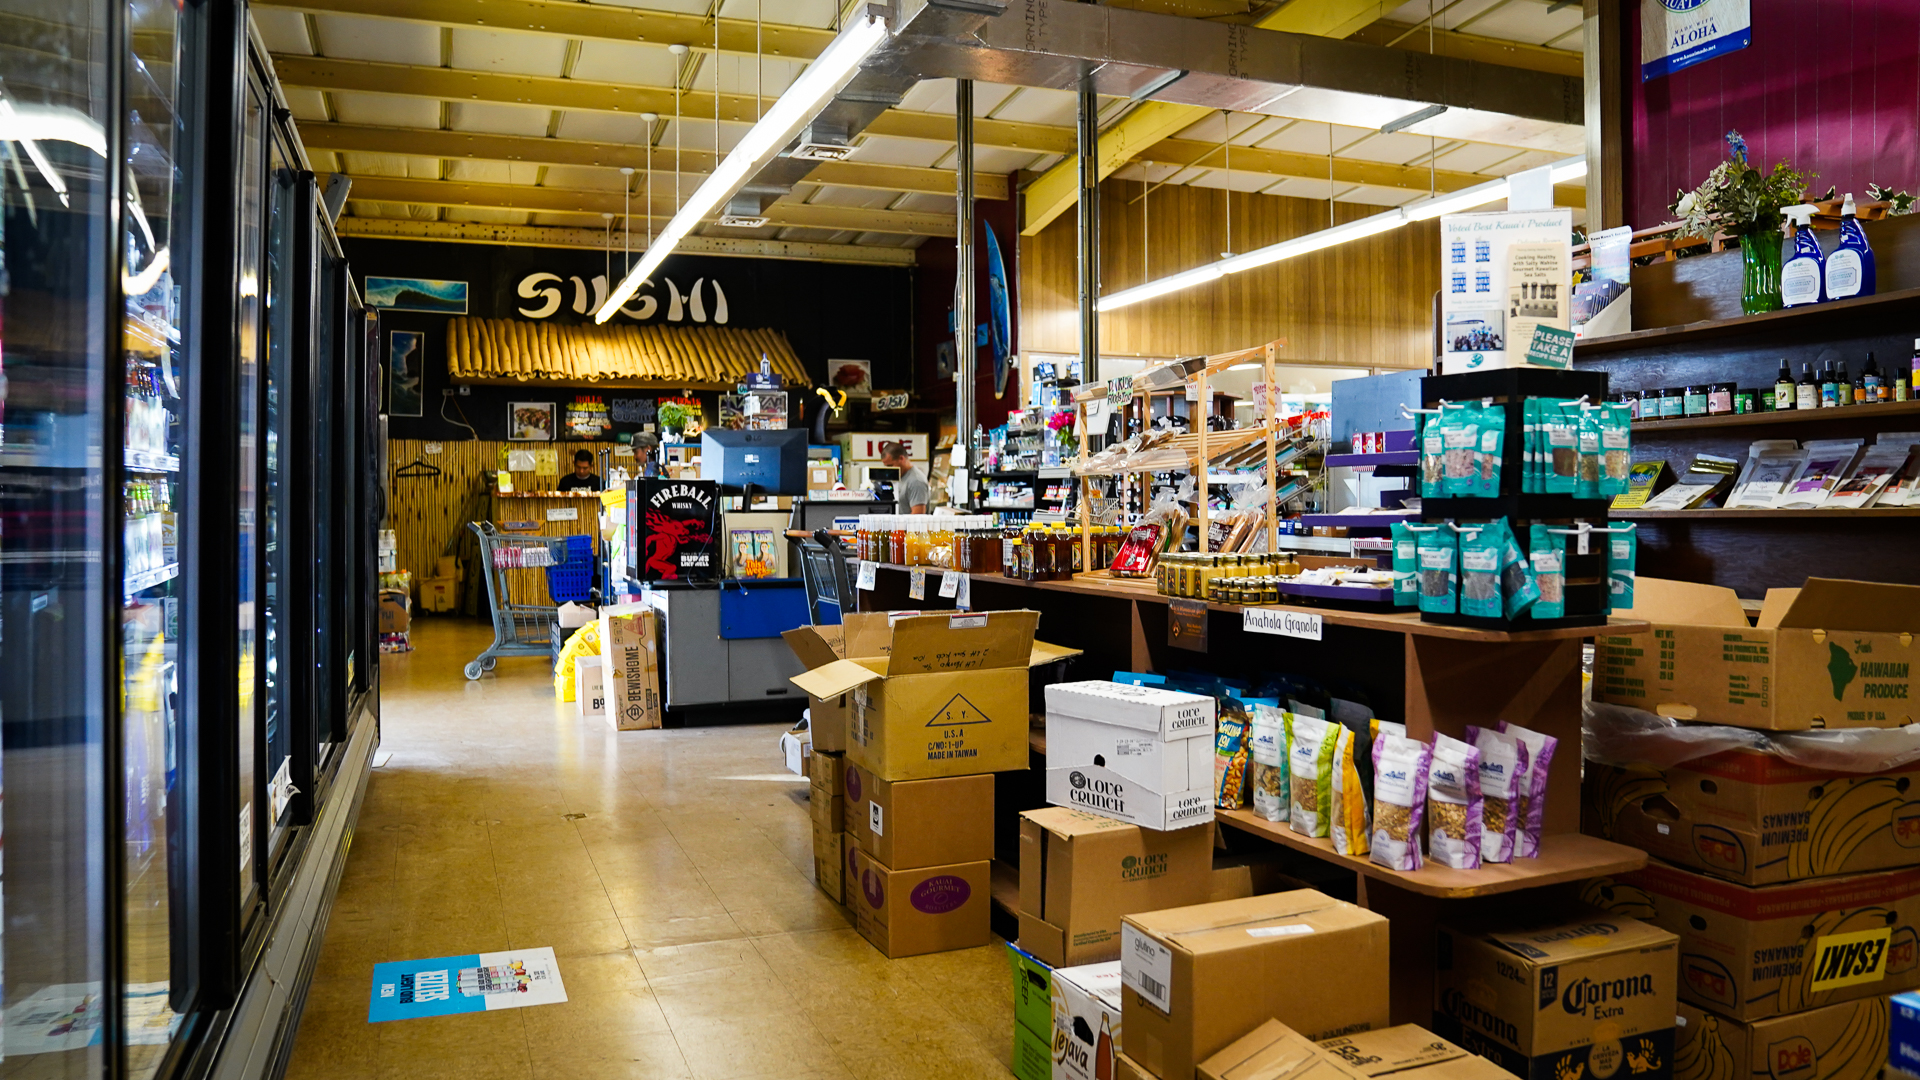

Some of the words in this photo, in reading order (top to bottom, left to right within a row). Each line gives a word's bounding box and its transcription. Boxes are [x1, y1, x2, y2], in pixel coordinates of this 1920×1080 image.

[1671, 23, 1717, 49] ALOHA
[1448, 223, 1471, 232] Voted
[1473, 222, 1493, 231] Best
[1527, 218, 1562, 228] Product
[1534, 330, 1572, 348] PLEASE
[1532, 340, 1559, 355] TAKE
[1560, 347, 1568, 357] A
[650, 484, 712, 510] FIREBALL
[1244, 610, 1282, 630] Anahola
[1284, 613, 1319, 634] Granola
[1655, 630, 1664, 638] NET
[625, 646, 641, 702] BEWISHOME
[1860, 662, 1909, 678] HAWAIIAN
[1864, 684, 1909, 699] PRODUCE
[1847, 711, 1865, 720] PRODUCE
[944, 729, 964, 738] U.S.A
[1218, 723, 1241, 737] MAUNA
[1218, 735, 1230, 748] LOA
[928, 751, 945, 760] MADE
[946, 751, 953, 759] IN
[955, 749, 978, 759] TAIWAN
[1763, 810, 1811, 829] BANANAS
[1896, 817, 1920, 839] ole
[1761, 827, 1809, 847] PREMIUM
[1700, 838, 1737, 863] Dole
[920, 885, 961, 898] GOURMET
[928, 879, 953, 888] KAUAI
[1532, 923, 1619, 943] Corona
[1135, 937, 1155, 956] glutino
[1754, 944, 1804, 964] BANANAS
[1813, 938, 1887, 983] ESAKI
[1543, 972, 1554, 988] 12
[1752, 962, 1803, 982] PREMIUM
[380, 983, 396, 998] NEW
[399, 973, 415, 991] LIGHT
[414, 969, 450, 1003] SELTZER
[1019, 968, 1029, 1006] DEEP
[1688, 968, 1726, 996] Dole
[399, 990, 414, 1004] BUD
[1562, 973, 1653, 1016] Corona
[1442, 987, 1519, 1046] Corona
[1594, 1005, 1624, 1020] Extra
[1592, 1050, 1620, 1060] CERVEZA
[1778, 1044, 1811, 1070] Dole
